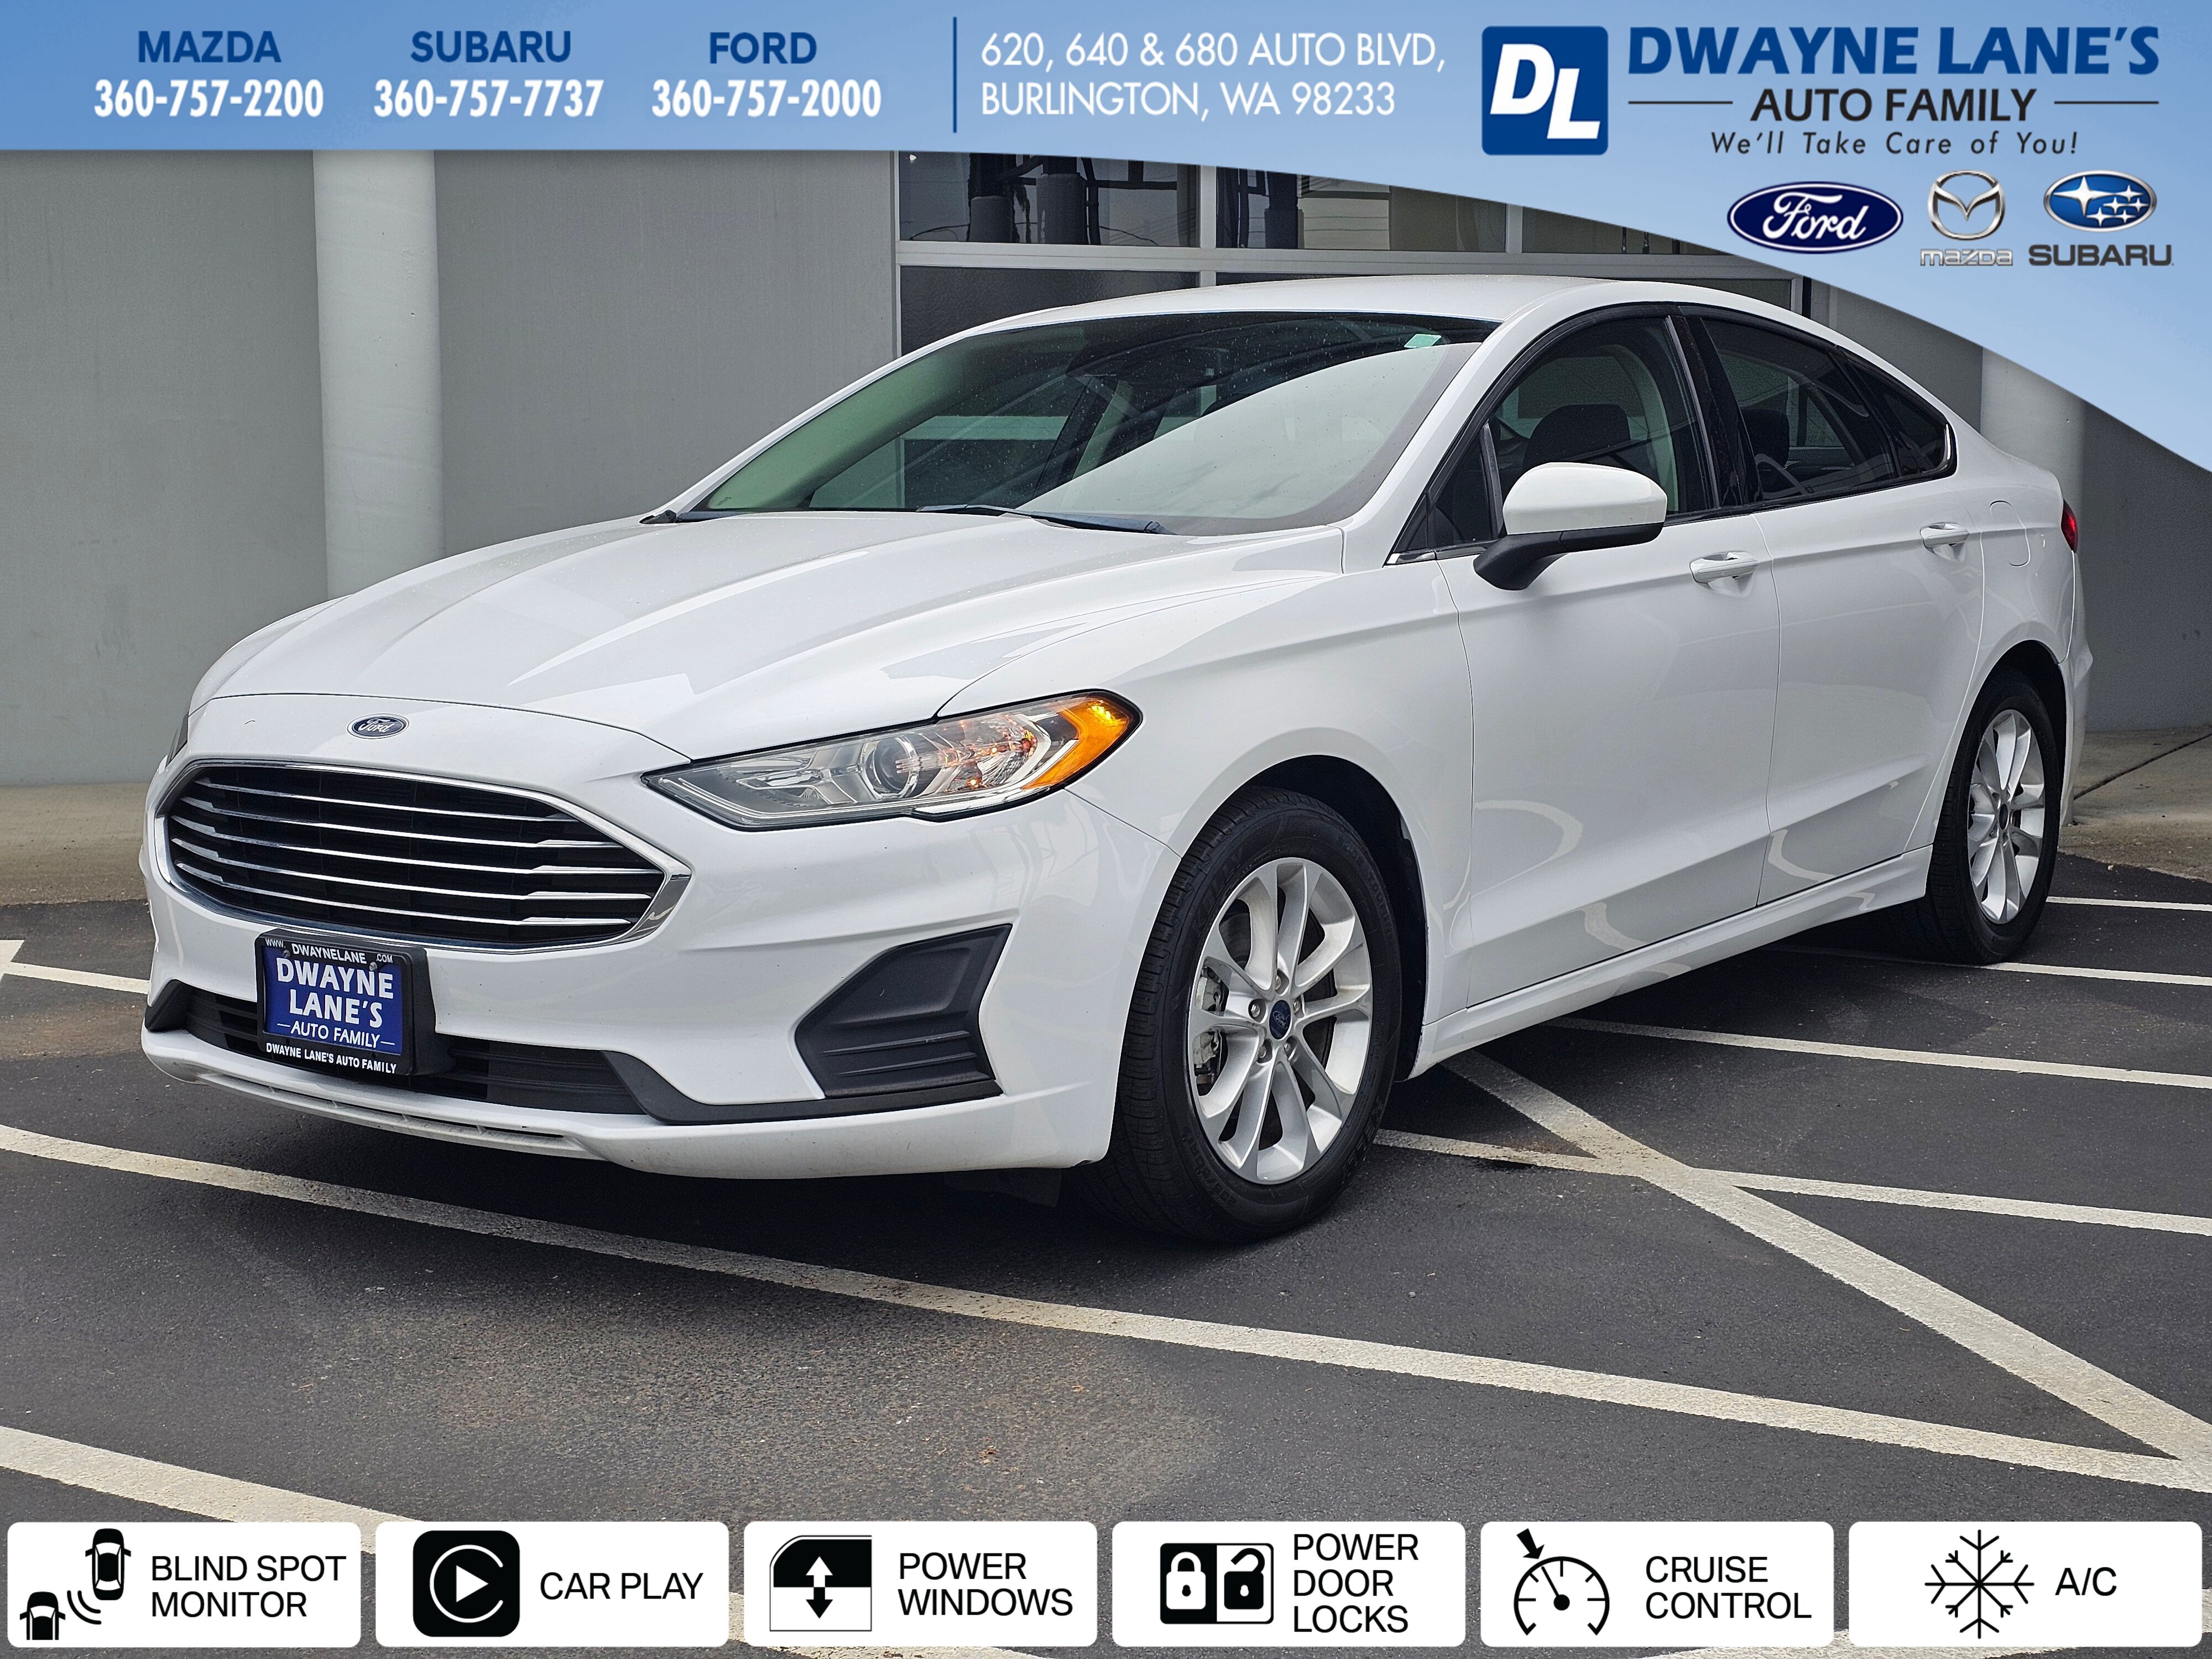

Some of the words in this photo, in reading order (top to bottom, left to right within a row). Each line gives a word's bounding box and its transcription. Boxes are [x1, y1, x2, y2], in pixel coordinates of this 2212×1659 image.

[358, 718, 395, 733] Ford
[291, 943, 367, 964] DWAYNELANE
[276, 957, 394, 999] DWAYNE
[290, 989, 383, 1028] LANE'S
[290, 1021, 330, 1040] AUTO
[333, 1027, 380, 1048] FAMILY
[266, 1042, 302, 1058] DWAYNE
[304, 1049, 335, 1064] LANE'S
[336, 1055, 360, 1068] AUTO
[362, 1058, 397, 1074] FAMILY
